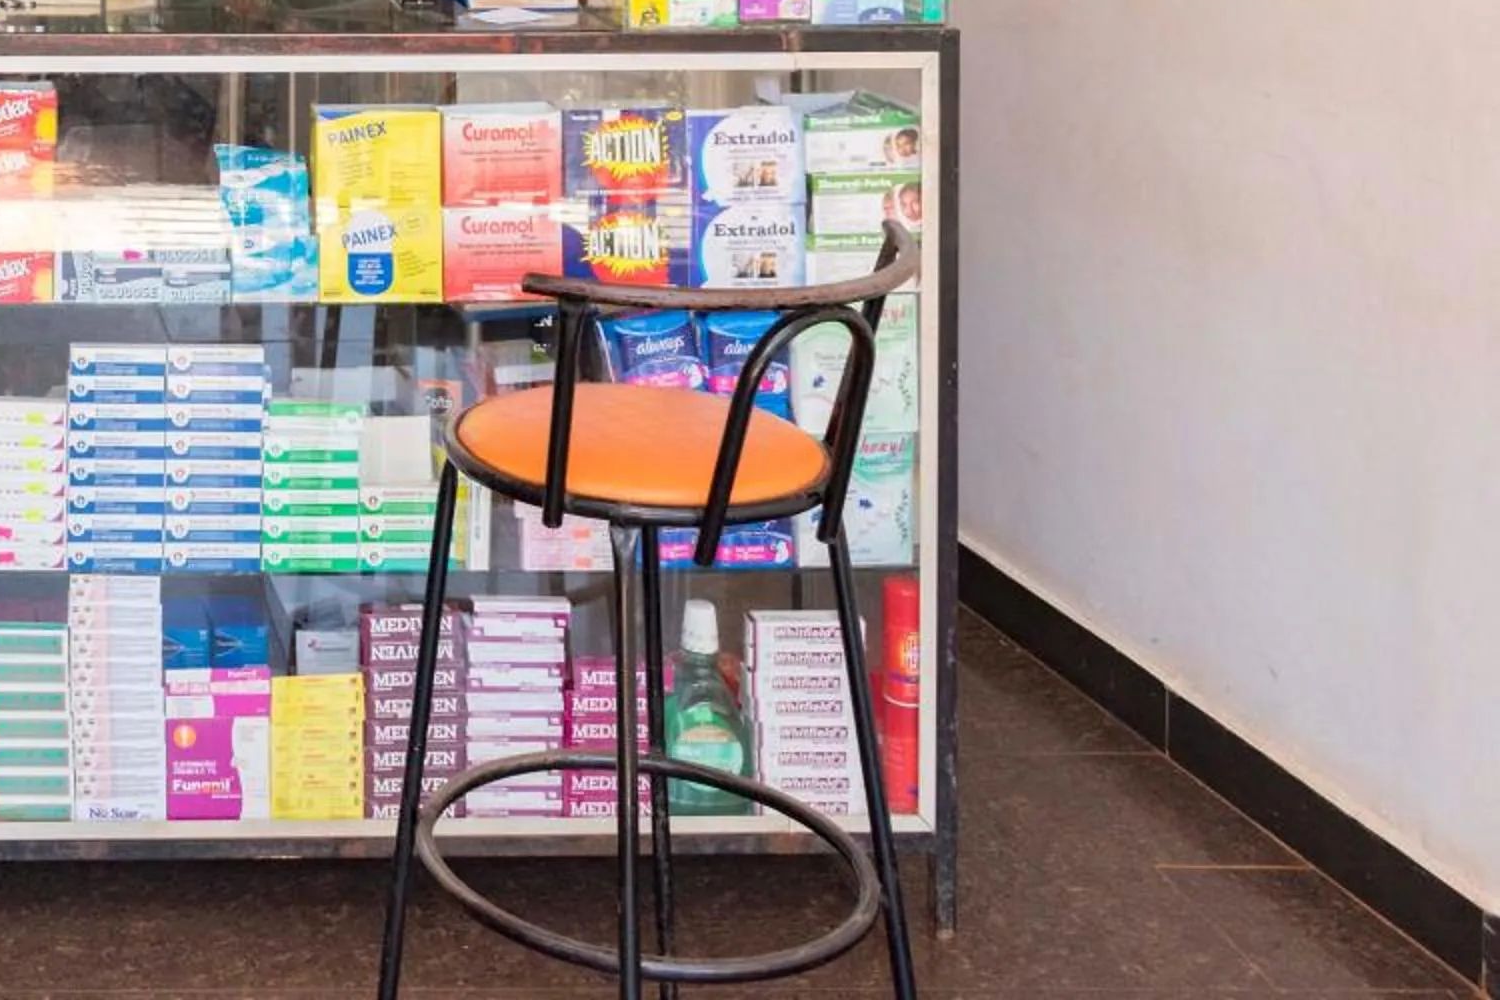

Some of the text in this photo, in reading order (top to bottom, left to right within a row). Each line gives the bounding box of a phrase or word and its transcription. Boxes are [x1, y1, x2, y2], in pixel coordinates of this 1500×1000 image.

[328, 119, 387, 146] PAINEX
[462, 121, 534, 142] Curamol
[714, 130, 796, 147] Extradol
[590, 121, 661, 165] ACTION
[461, 215, 534, 234] Curamol
[714, 221, 796, 237] Extradol
[341, 222, 399, 249] PAINEX
[589, 219, 660, 260] ACTION
[373, 670, 456, 687] MEDEN
